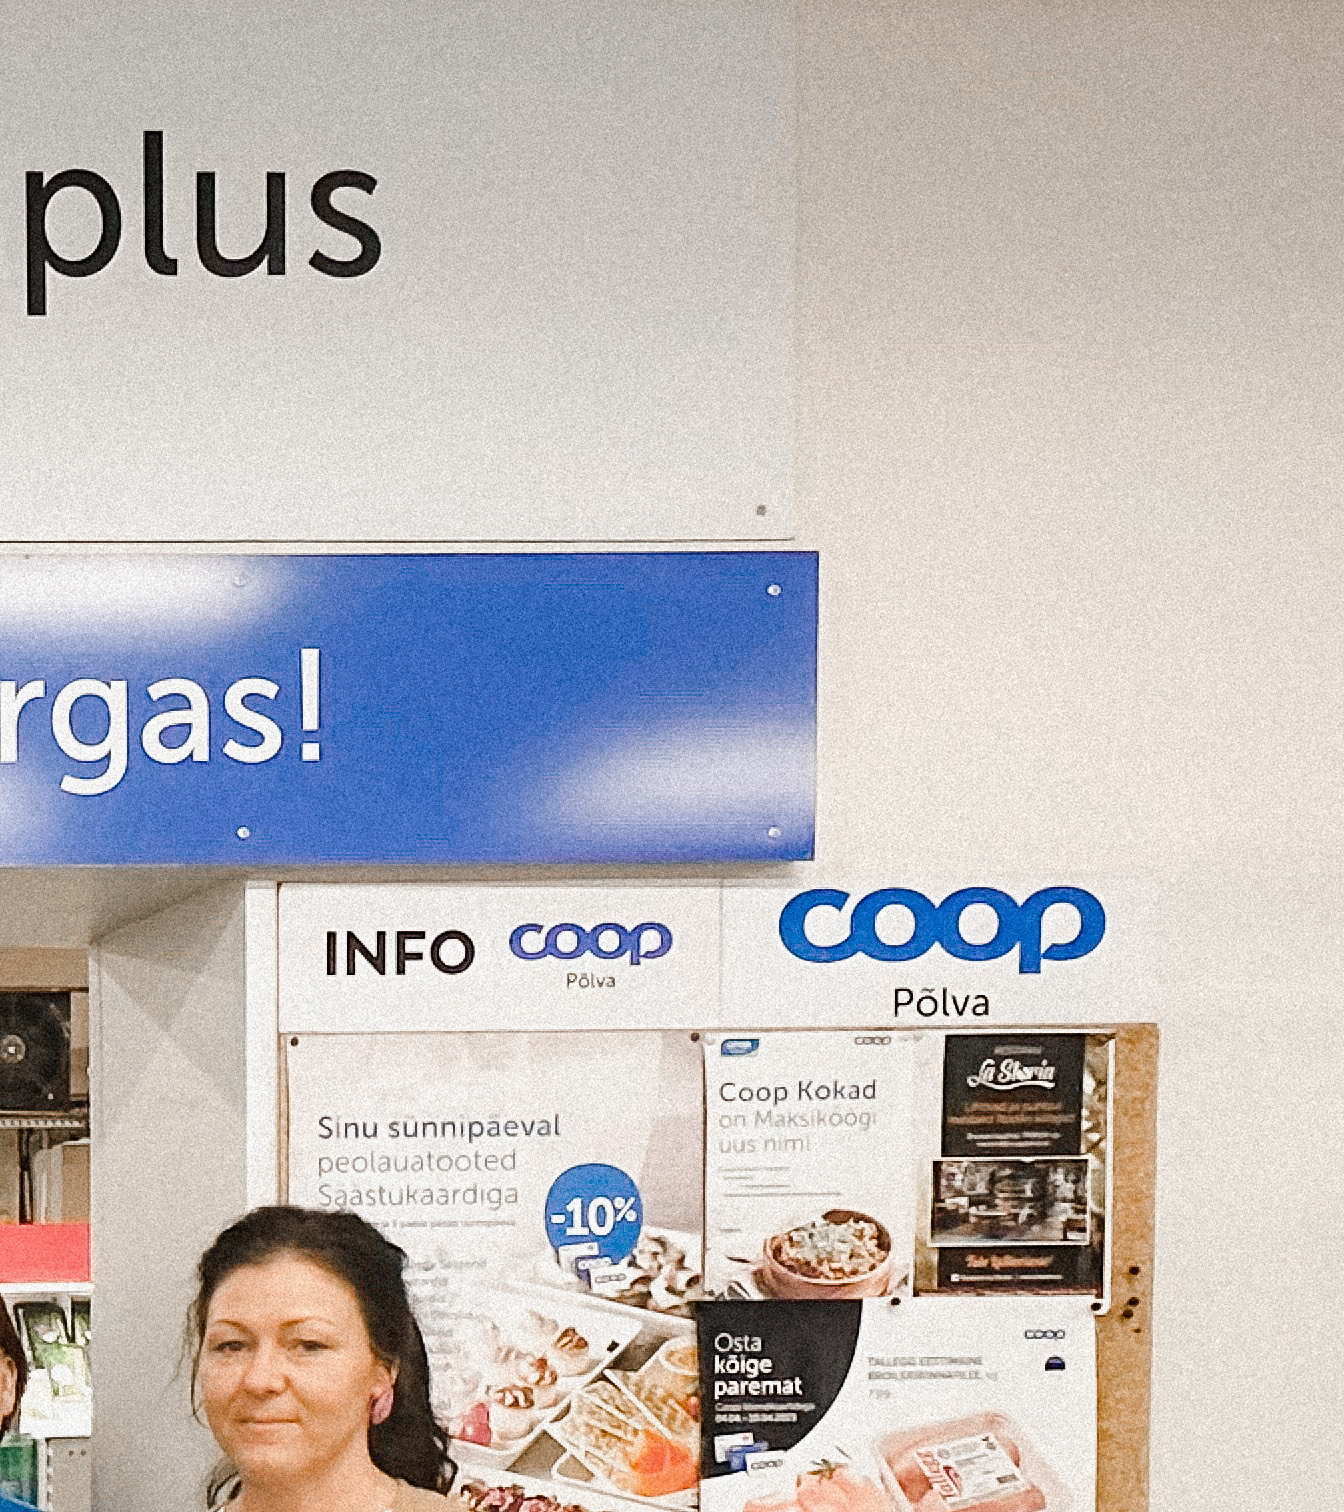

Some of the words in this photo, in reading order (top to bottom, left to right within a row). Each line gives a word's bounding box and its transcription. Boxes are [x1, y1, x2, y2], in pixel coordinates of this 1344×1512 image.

[778, 886, 1106, 974] coop
[326, 929, 476, 976] INFO
[509, 922, 673, 965] coop
[566, 971, 617, 990] Põlva
[893, 986, 991, 1018] Põlva
[718, 1081, 789, 1107] Coop
[798, 1079, 878, 1102] Kokad
[317, 1115, 378, 1140] Sinu
[718, 1112, 747, 1128] on
[317, 1149, 517, 1178] peolauatooted
[550, 1196, 638, 1237] -10%
[713, 1332, 763, 1353] Osta
[713, 1355, 773, 1379] kõige
[713, 1378, 803, 1399] paremat
